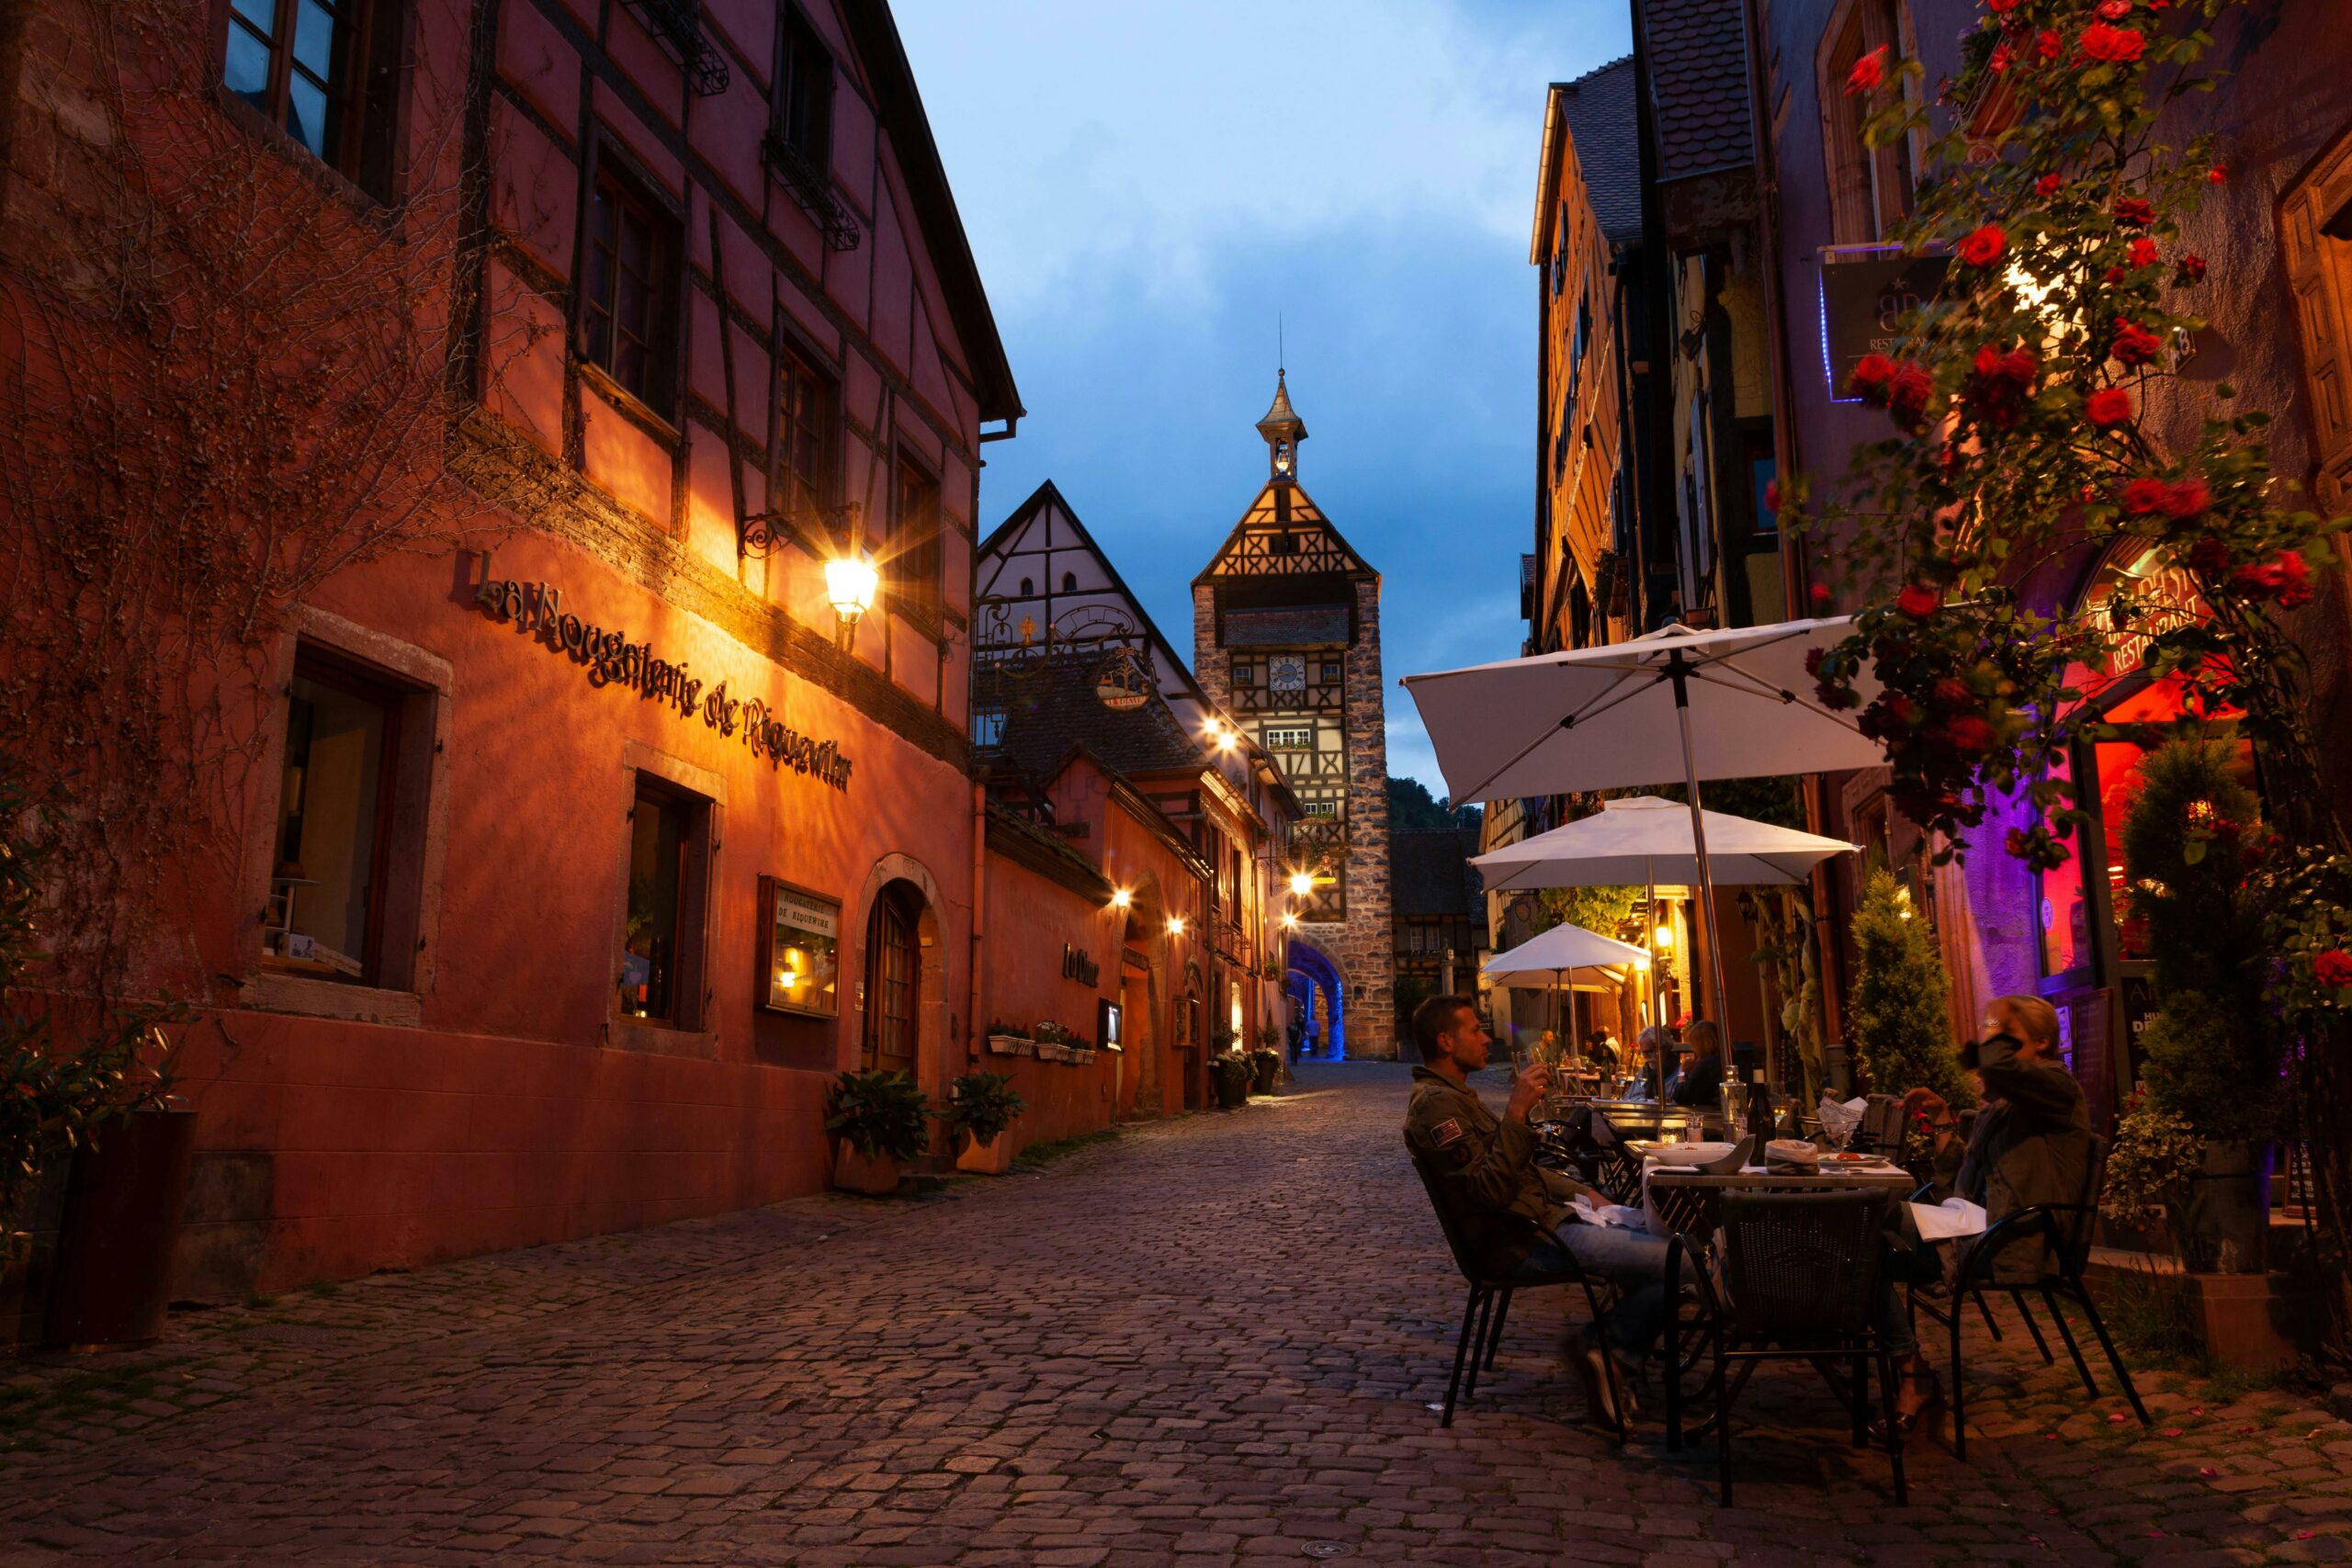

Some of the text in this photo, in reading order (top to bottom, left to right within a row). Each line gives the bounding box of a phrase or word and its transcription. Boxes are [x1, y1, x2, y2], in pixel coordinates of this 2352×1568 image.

[472, 549, 525, 622] La
[533, 581, 704, 711] Nougaterie
[704, 679, 740, 737] de
[783, 894, 825, 914] NOUGATERIE
[778, 907, 829, 929] DE RIQUEWIHR
